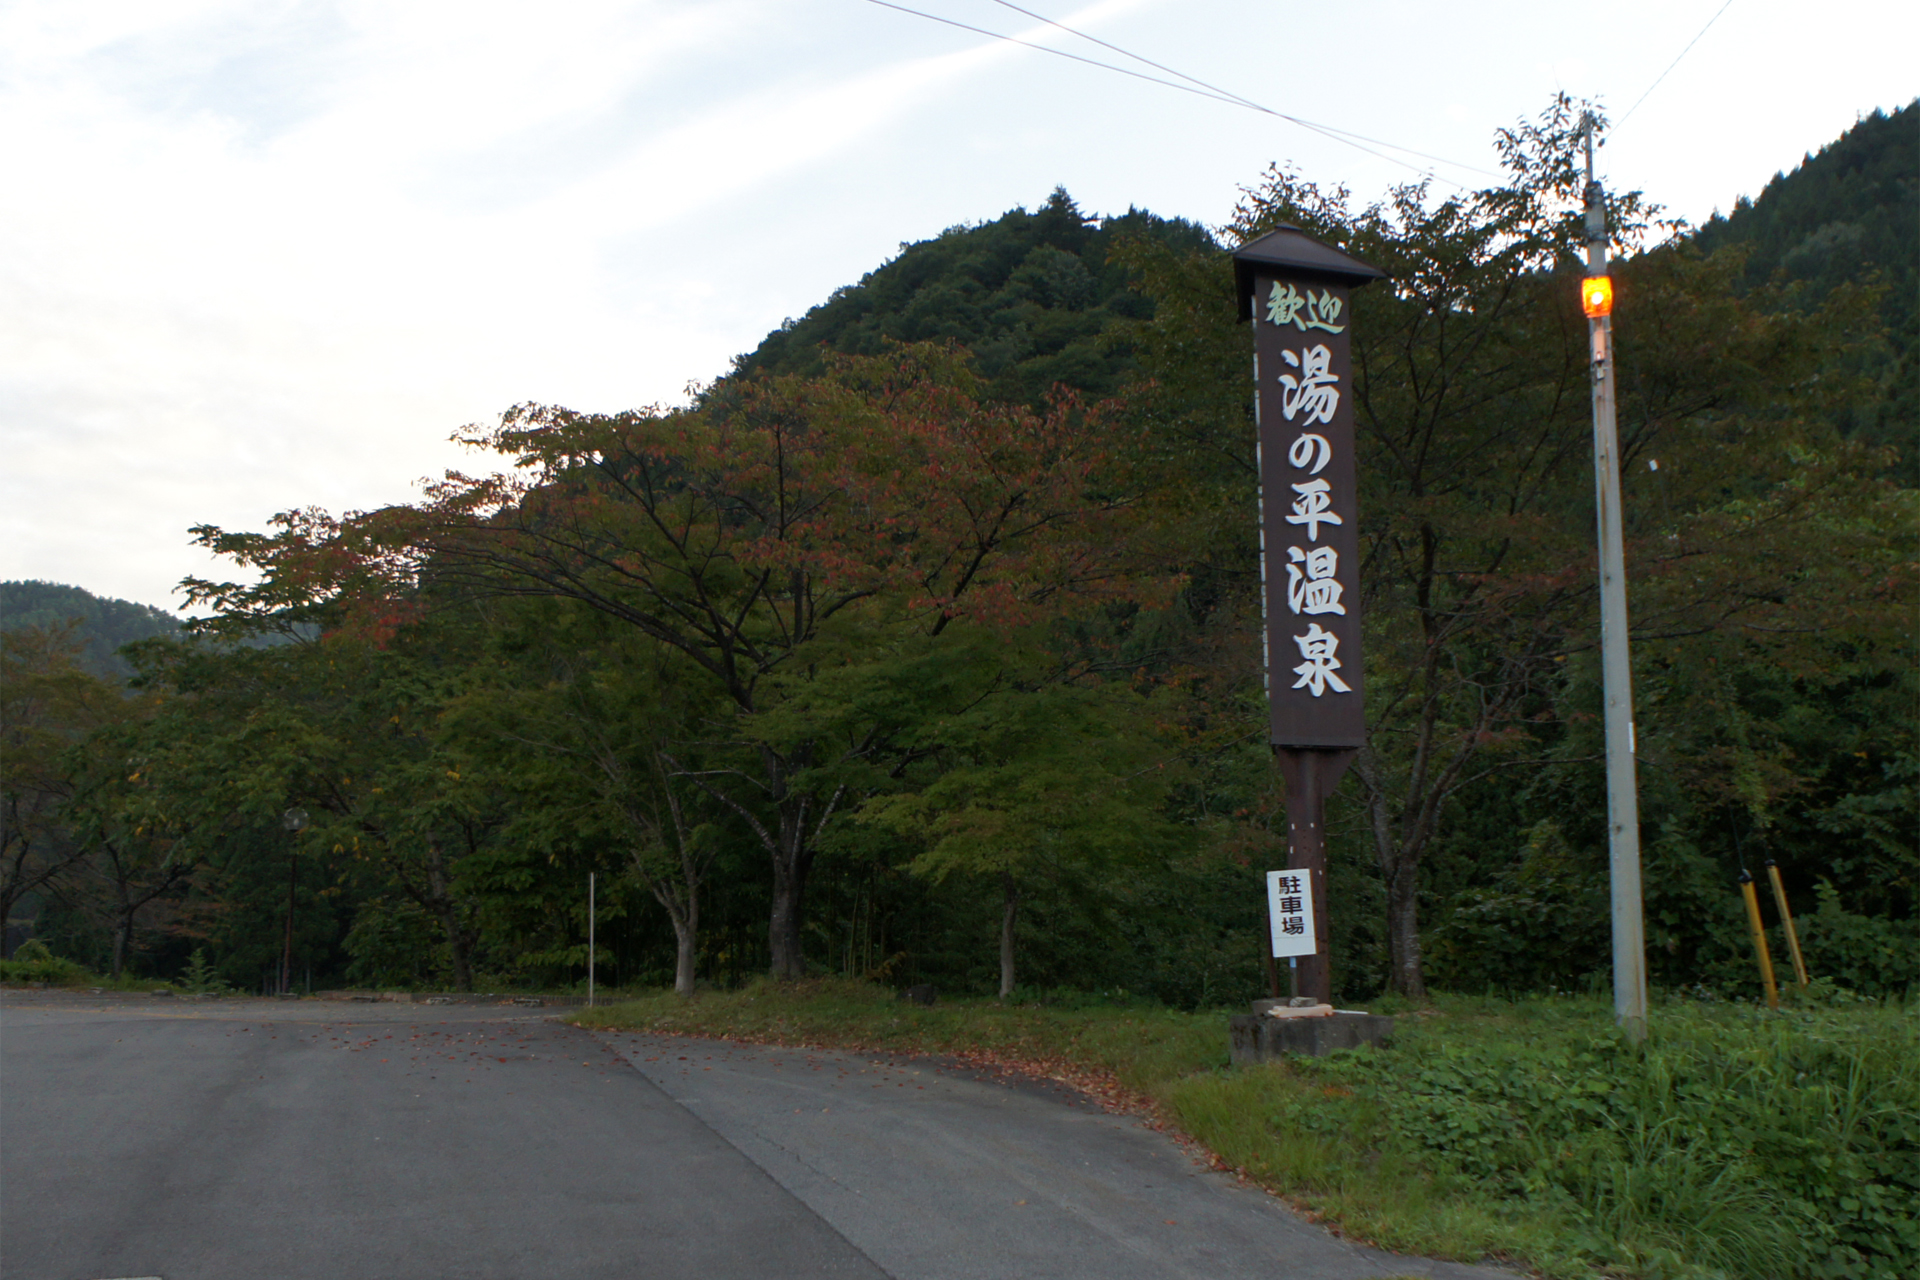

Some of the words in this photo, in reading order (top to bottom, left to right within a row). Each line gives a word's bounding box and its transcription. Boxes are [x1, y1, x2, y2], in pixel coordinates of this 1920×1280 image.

[1265, 280, 1346, 334] 歓迎
[1278, 344, 1352, 697] 湯の平温泉
[1278, 876, 1305, 935] 駐車場
